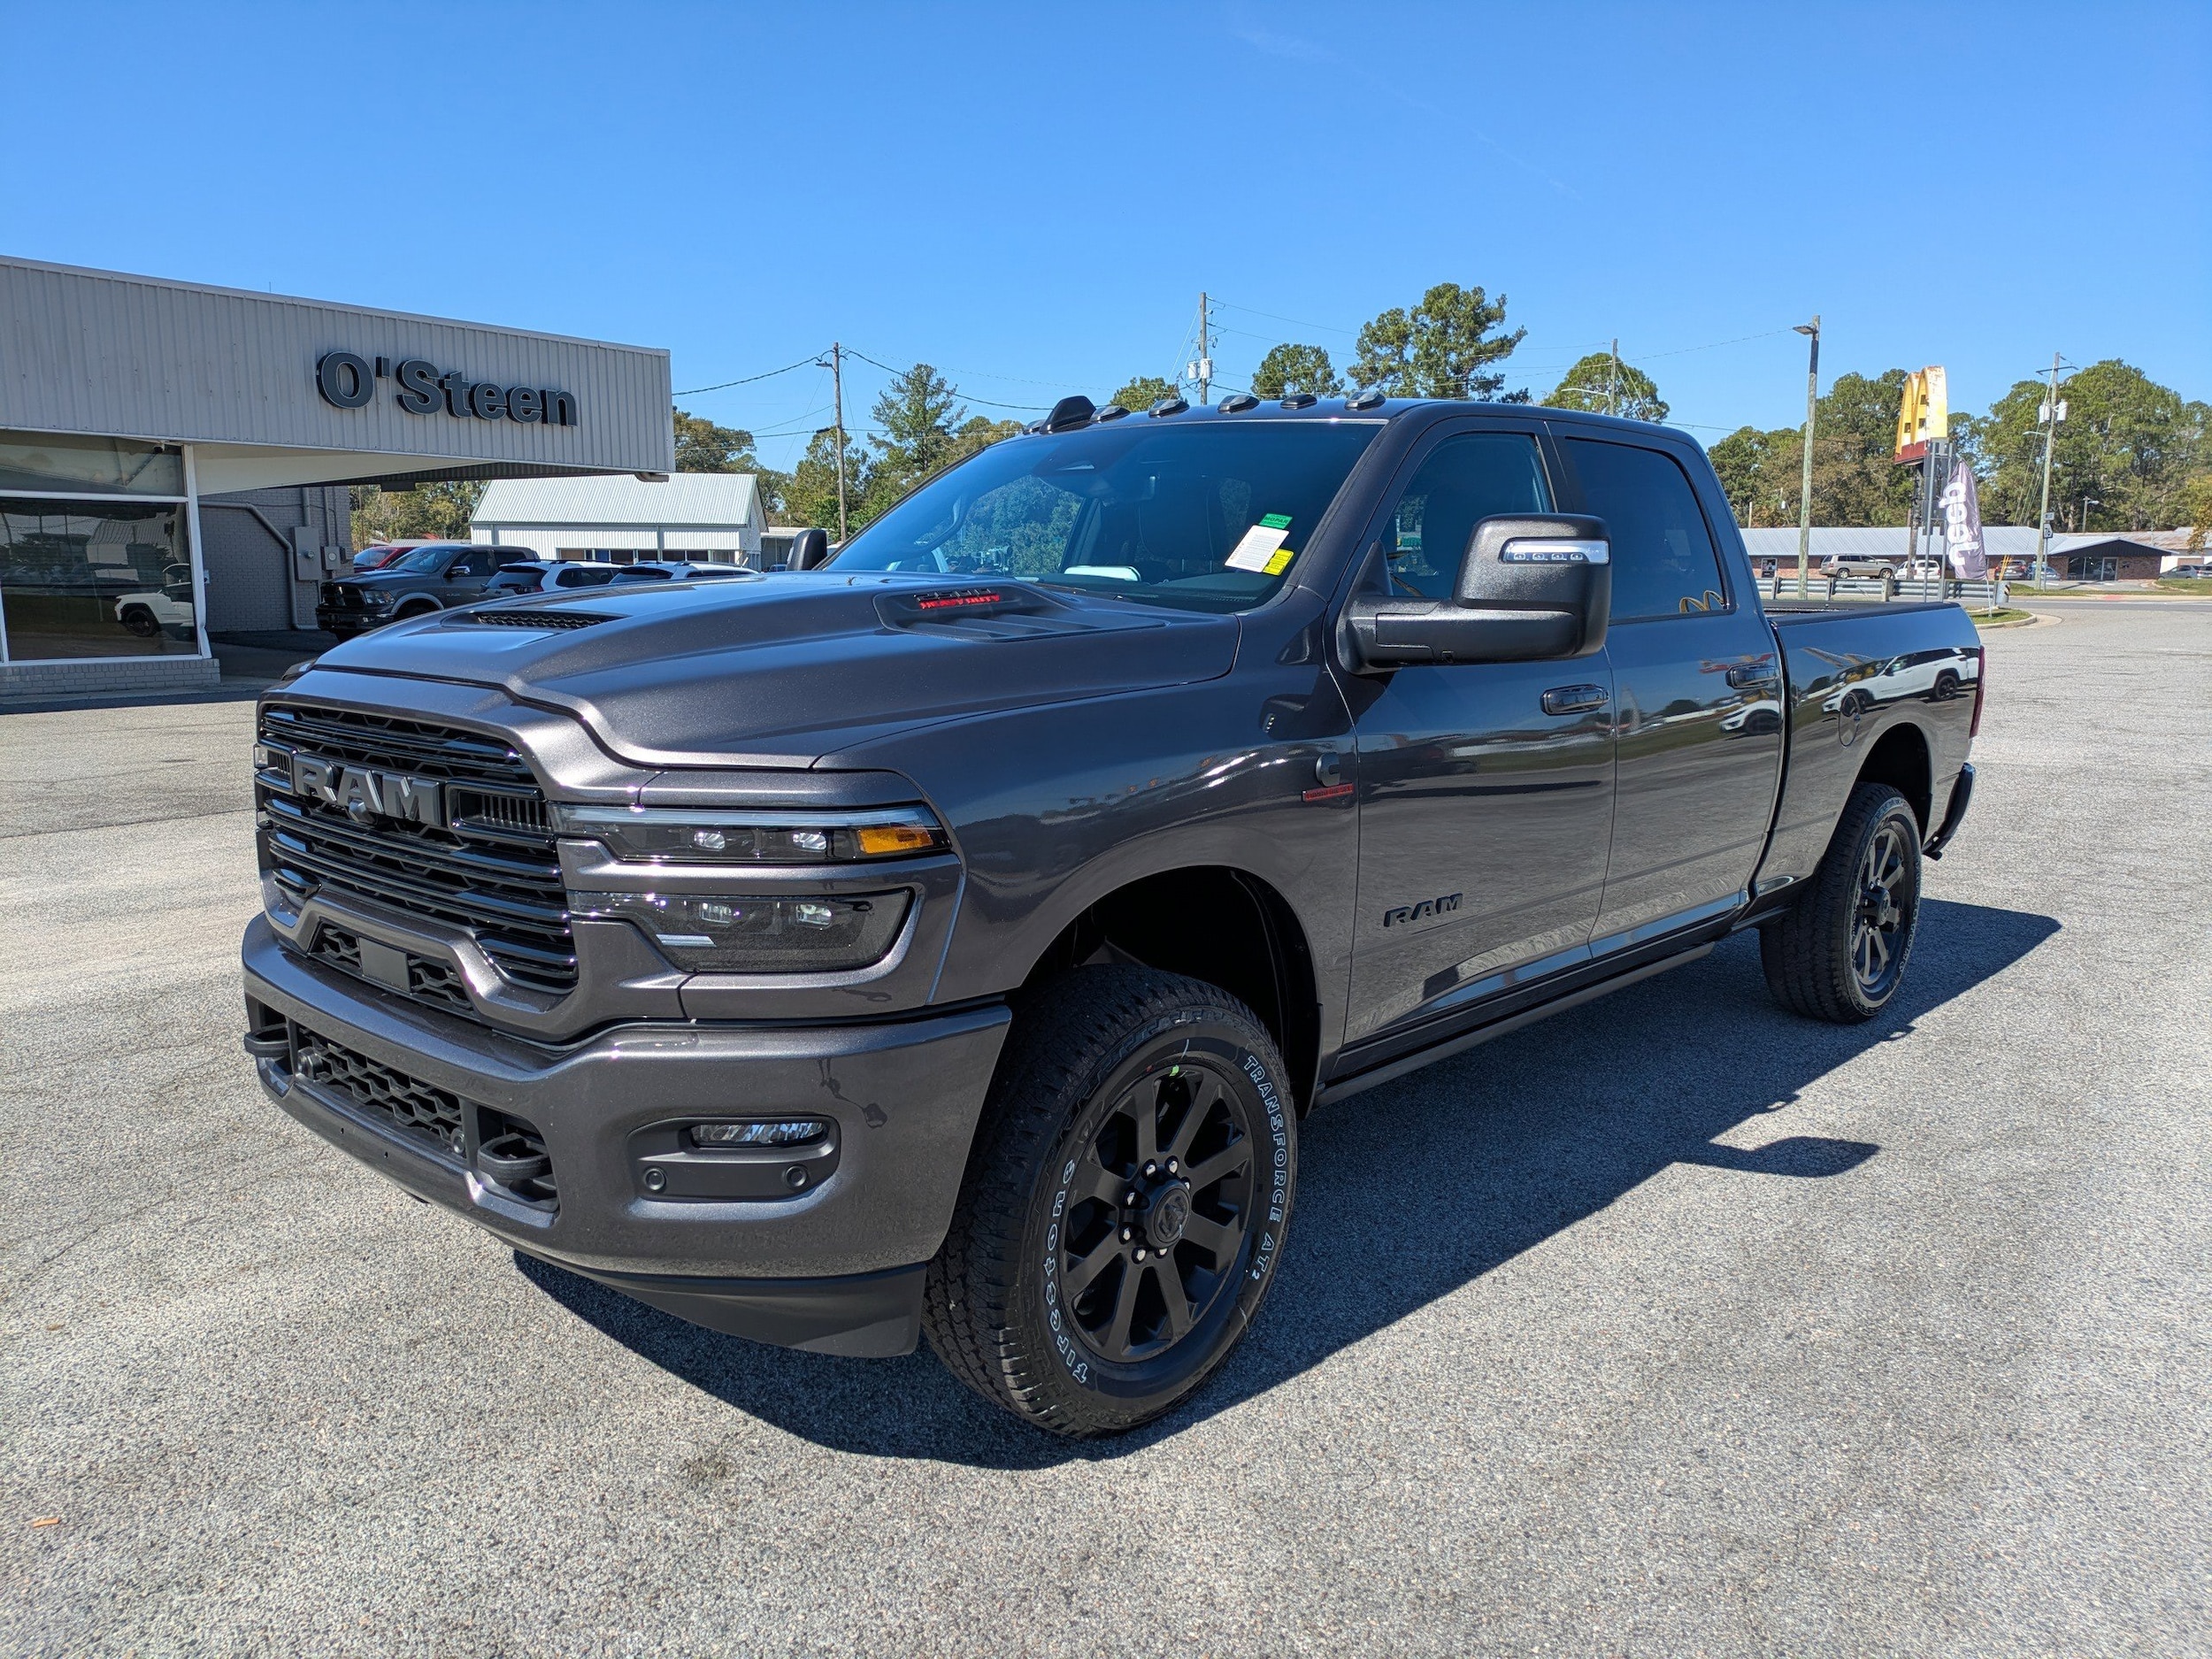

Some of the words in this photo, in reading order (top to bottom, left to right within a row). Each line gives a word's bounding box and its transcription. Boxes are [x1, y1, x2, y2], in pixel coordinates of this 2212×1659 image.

[317, 350, 578, 426] O'Steen
[293, 753, 442, 826] RAM
[1384, 893, 1463, 927] RAM
[1244, 1055, 1287, 1222] TRANSFORCE
